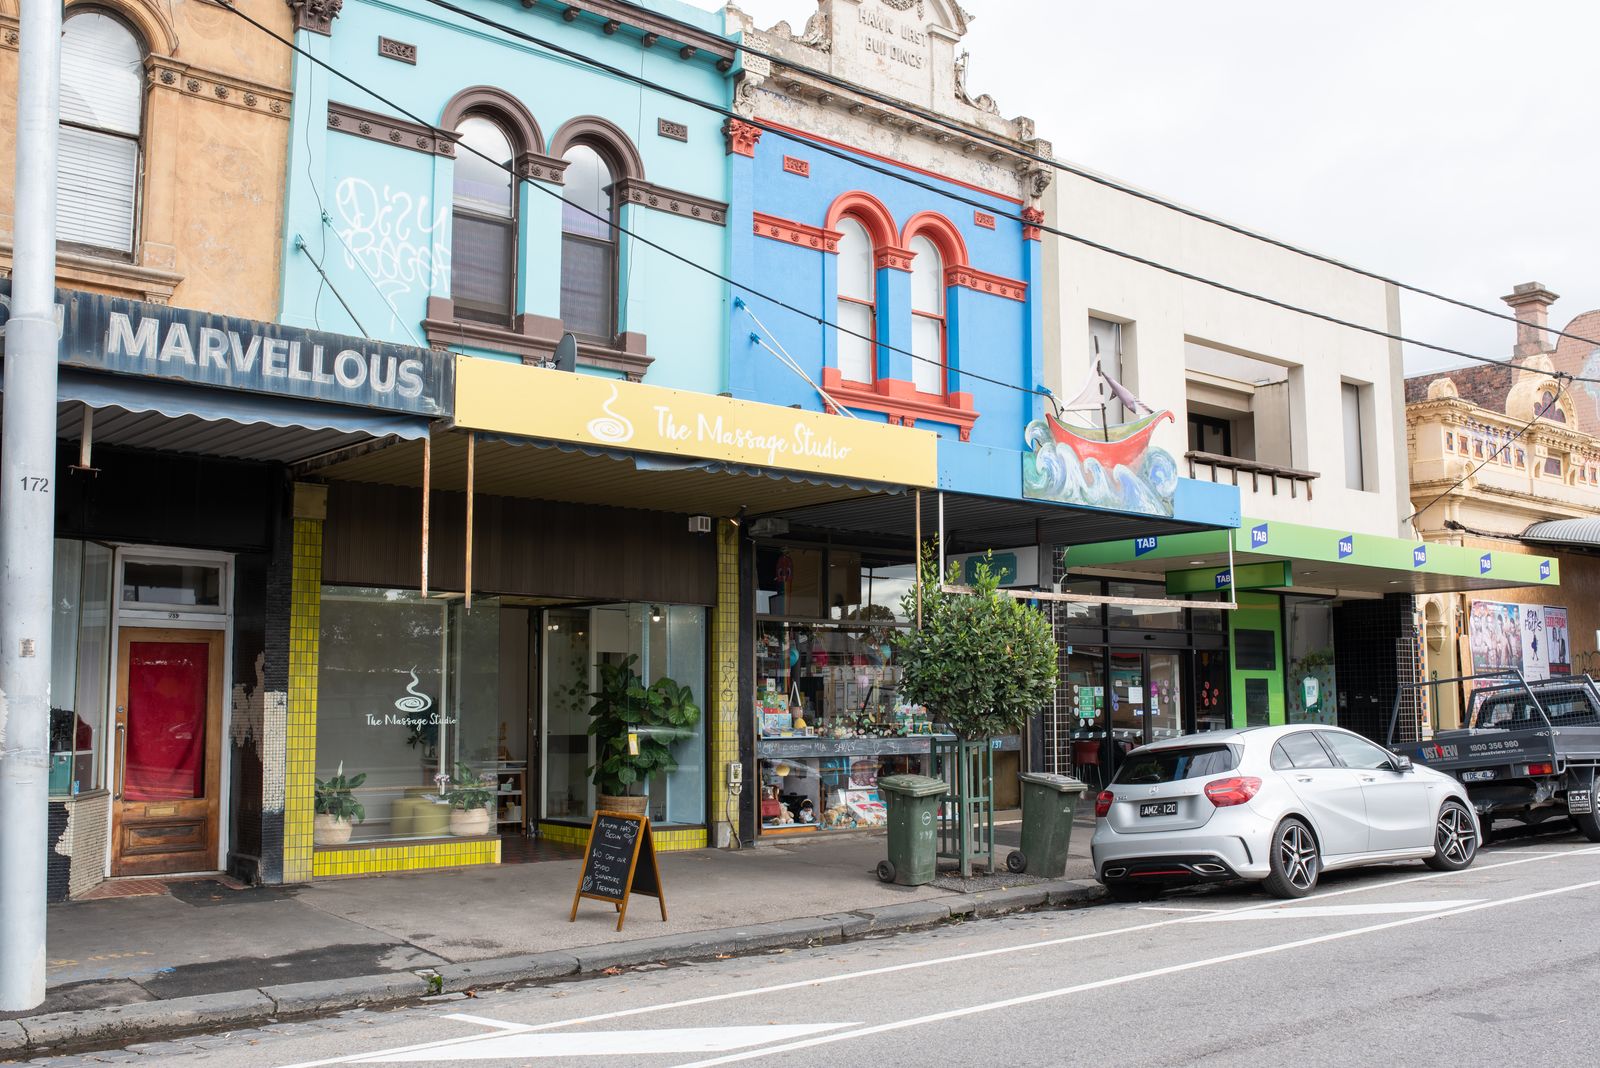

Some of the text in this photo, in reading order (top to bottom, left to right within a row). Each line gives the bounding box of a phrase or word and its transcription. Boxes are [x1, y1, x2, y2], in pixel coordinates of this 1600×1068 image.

[858, 7, 928, 47] HAWKURST
[107, 311, 424, 398] MARVELLOUS
[653, 405, 853, 464] The Massage Studio
[21, 476, 48, 493] 172
[1253, 529, 1267, 542] TAB
[1137, 537, 1156, 549] TAB
[1339, 542, 1353, 554] TAB
[1415, 550, 1426, 562] TAB
[1480, 558, 1491, 569] TAB
[1540, 565, 1550, 575] TAB
[1216, 574, 1231, 583] TAB
[365, 712, 457, 731] The Massage Studio
[1470, 743, 1487, 752] 1800
[1144, 805, 1158, 815] AMZ
